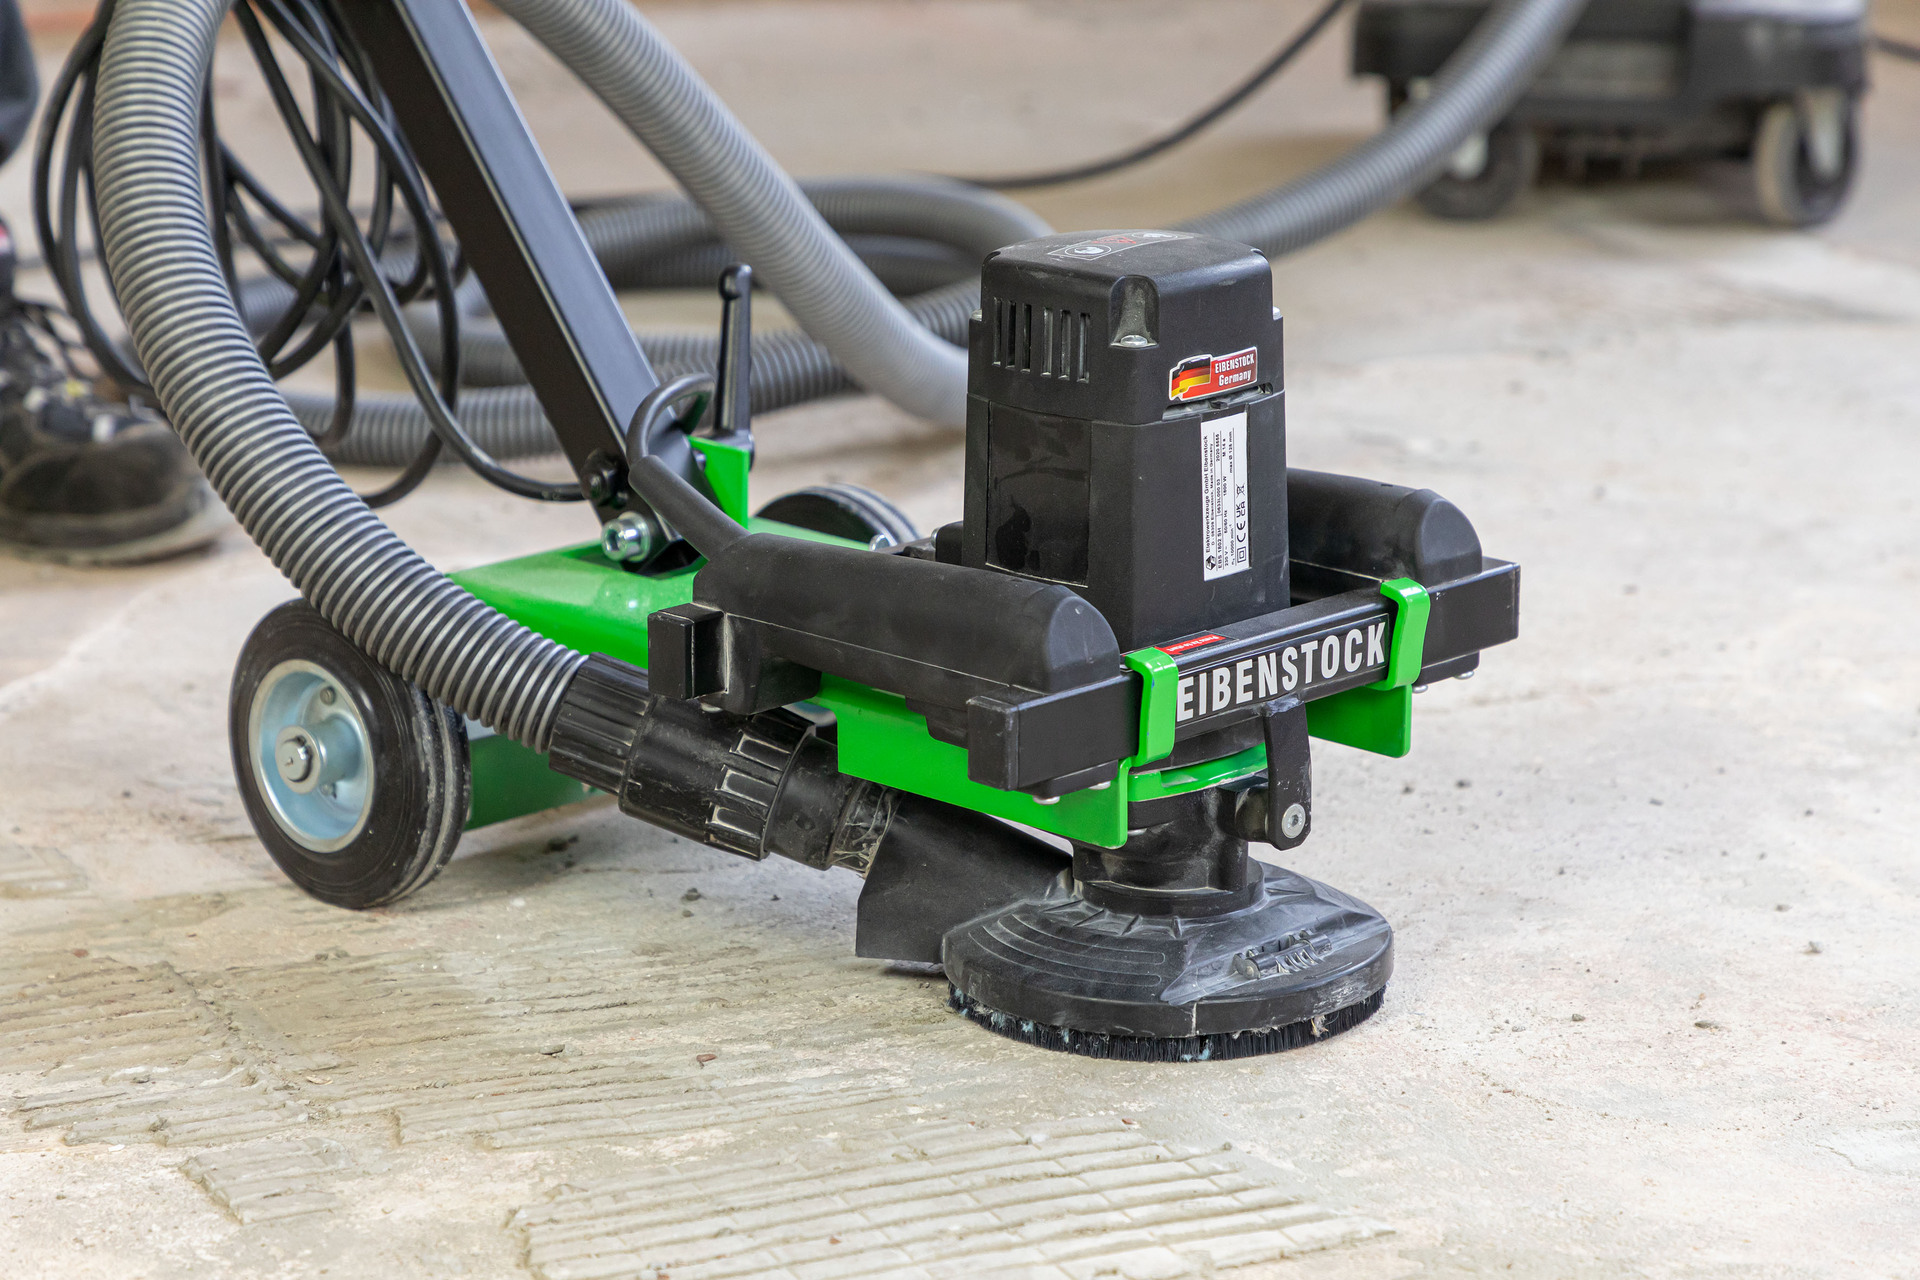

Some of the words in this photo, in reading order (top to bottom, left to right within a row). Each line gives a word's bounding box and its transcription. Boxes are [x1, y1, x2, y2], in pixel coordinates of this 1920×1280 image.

[1215, 353, 1255, 374] EIBENSTOCK
[1219, 369, 1251, 387] Germany
[1176, 622, 1386, 722] EIBENSTOCK
